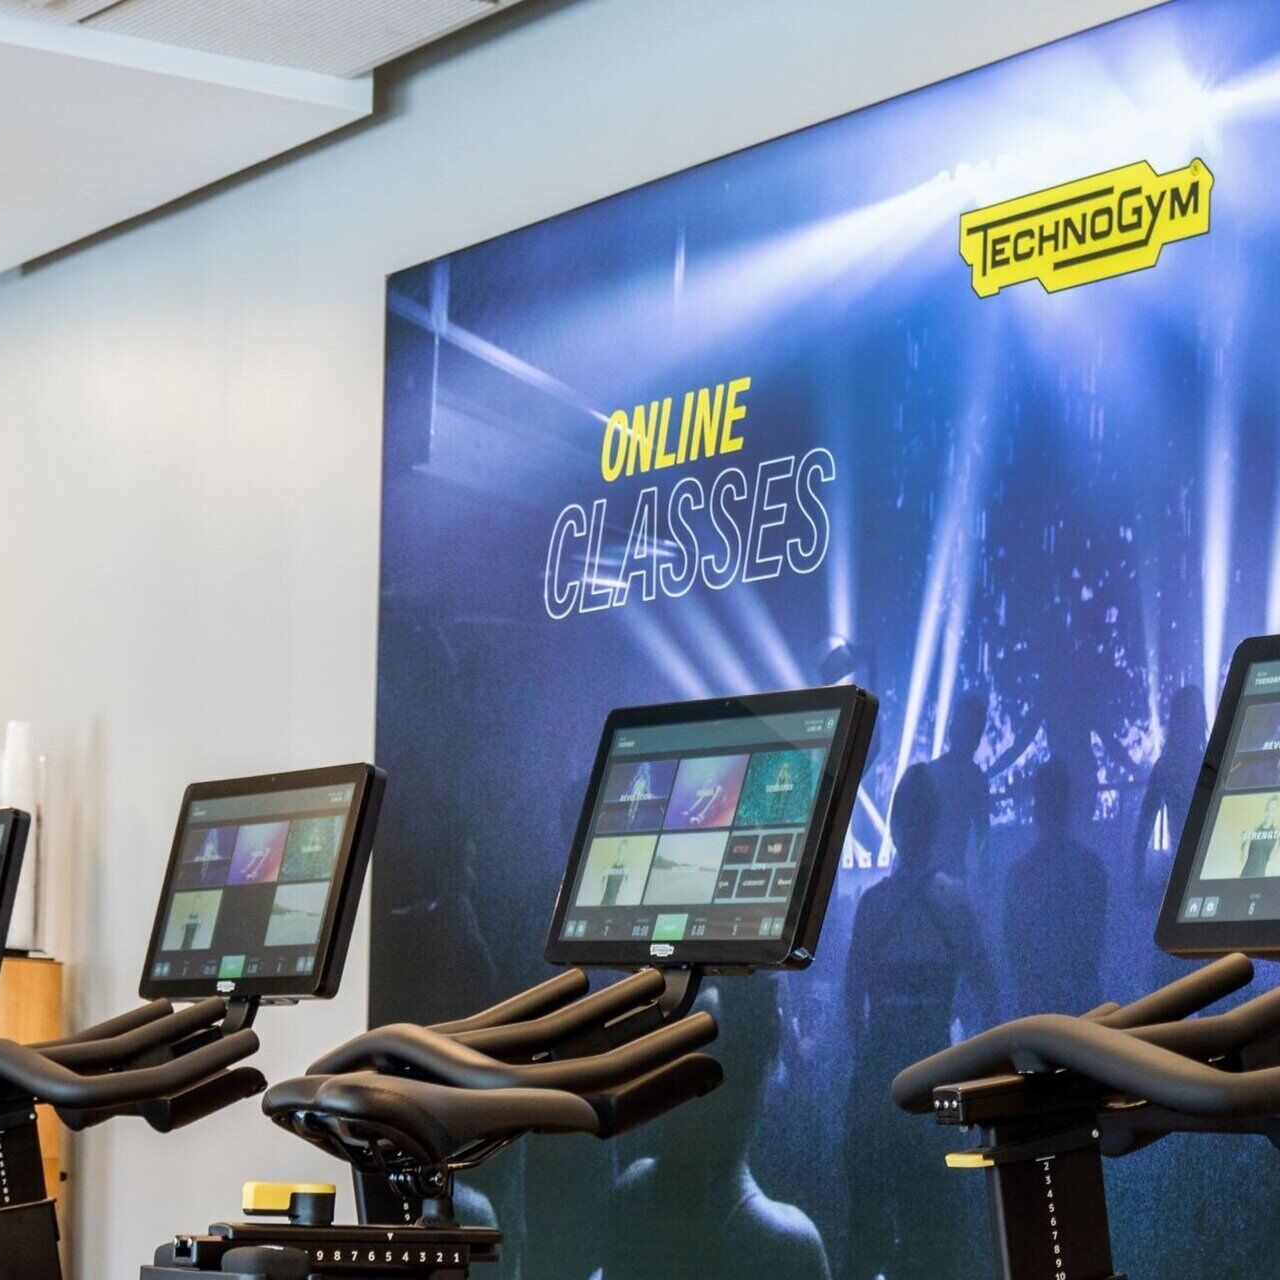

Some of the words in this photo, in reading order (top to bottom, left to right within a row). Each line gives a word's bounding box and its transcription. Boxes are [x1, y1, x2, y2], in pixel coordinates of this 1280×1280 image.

[966, 180, 1199, 277] TECHNOGYM
[601, 377, 751, 482] ONLINE
[544, 447, 836, 619] CLASSES
[1044, 1161, 1049, 1171] 2
[1045, 1175, 1051, 1184] 3
[1047, 1189, 1053, 1198] 4
[1049, 1203, 1054, 1212] 5
[405, 1213, 410, 1221] 9
[1051, 1217, 1056, 1226] 6
[1052, 1231, 1057, 1240] 7
[1054, 1244, 1060, 1254] 8
[317, 1250, 323, 1260] 9
[334, 1250, 341, 1261] 8
[351, 1251, 357, 1261] 7
[368, 1251, 375, 1261] 6
[386, 1251, 392, 1262] 5
[402, 1252, 409, 1262] 4
[420, 1252, 426, 1262] 3
[437, 1252, 443, 1262] 2
[454, 1253, 459, 1262] 1
[1056, 1258, 1062, 1268] 9
